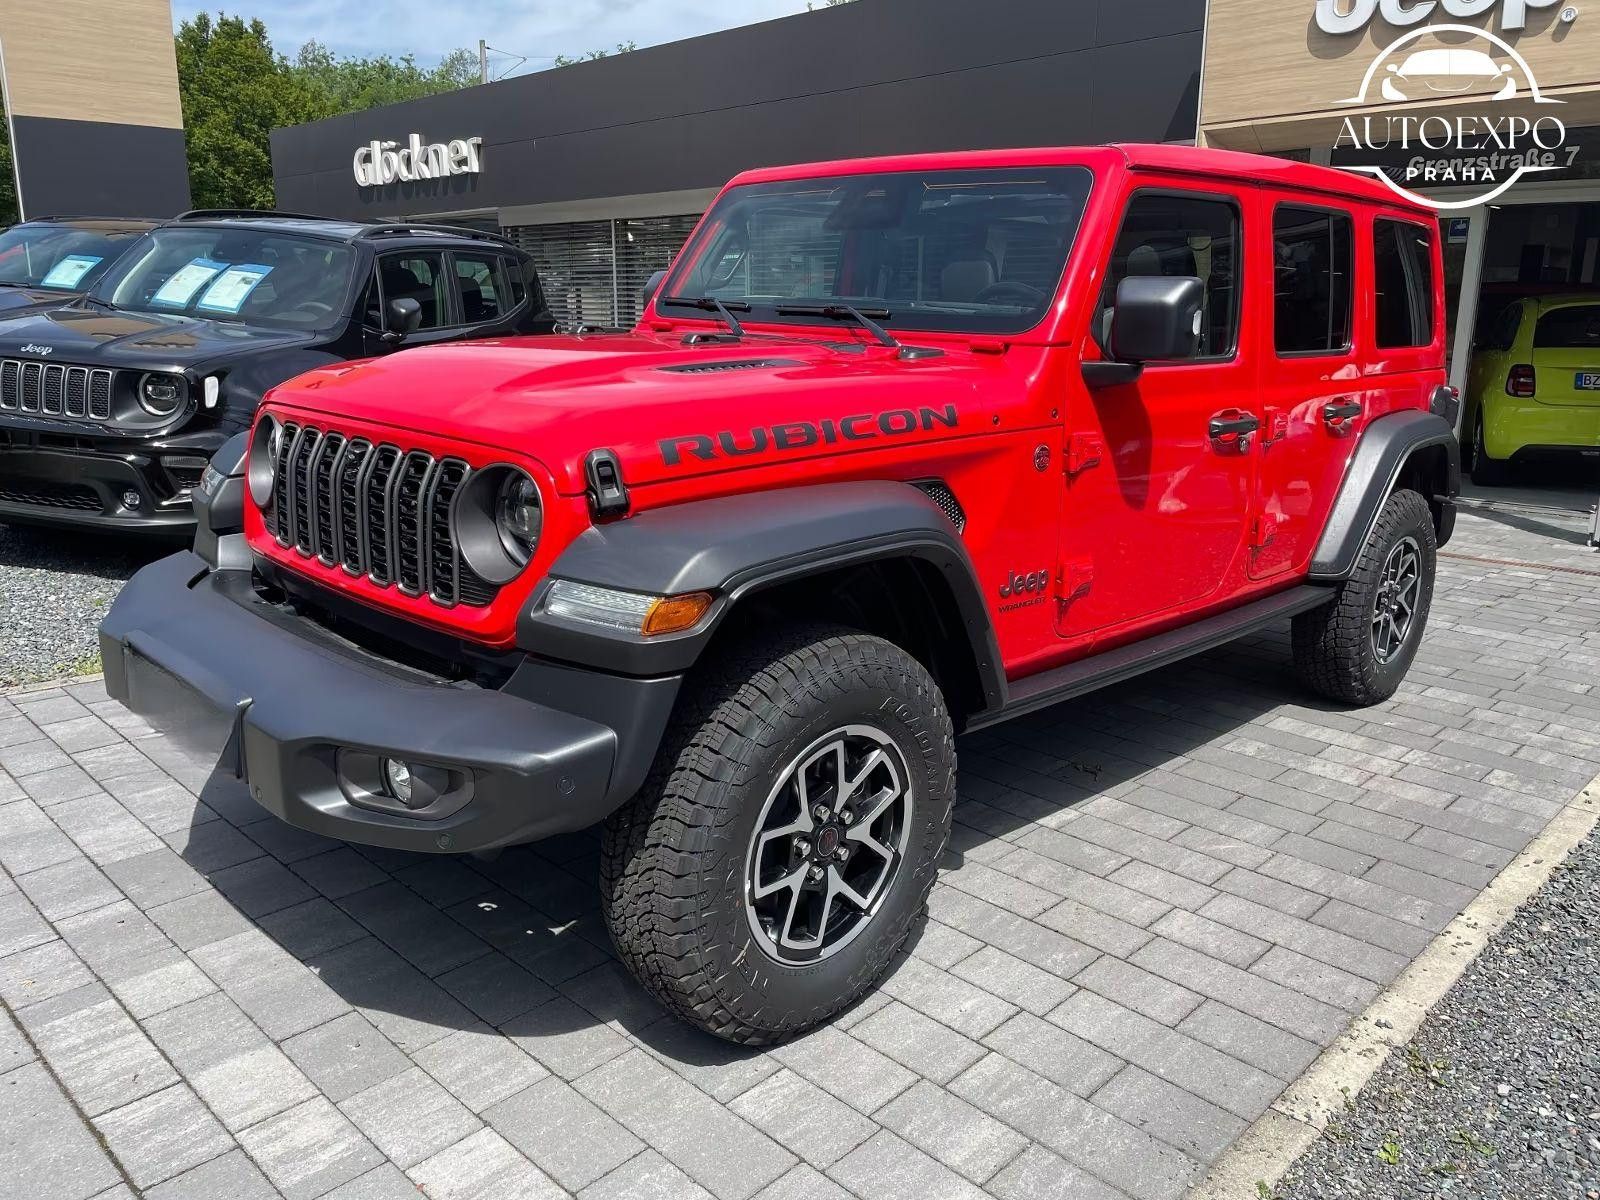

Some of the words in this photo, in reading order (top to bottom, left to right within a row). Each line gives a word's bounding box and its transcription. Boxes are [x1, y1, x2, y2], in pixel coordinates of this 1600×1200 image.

[353, 133, 482, 187] Glöckner
[1565, 145, 1581, 167] 7
[658, 404, 958, 466] RUBICON
[999, 569, 1048, 598] Jeep
